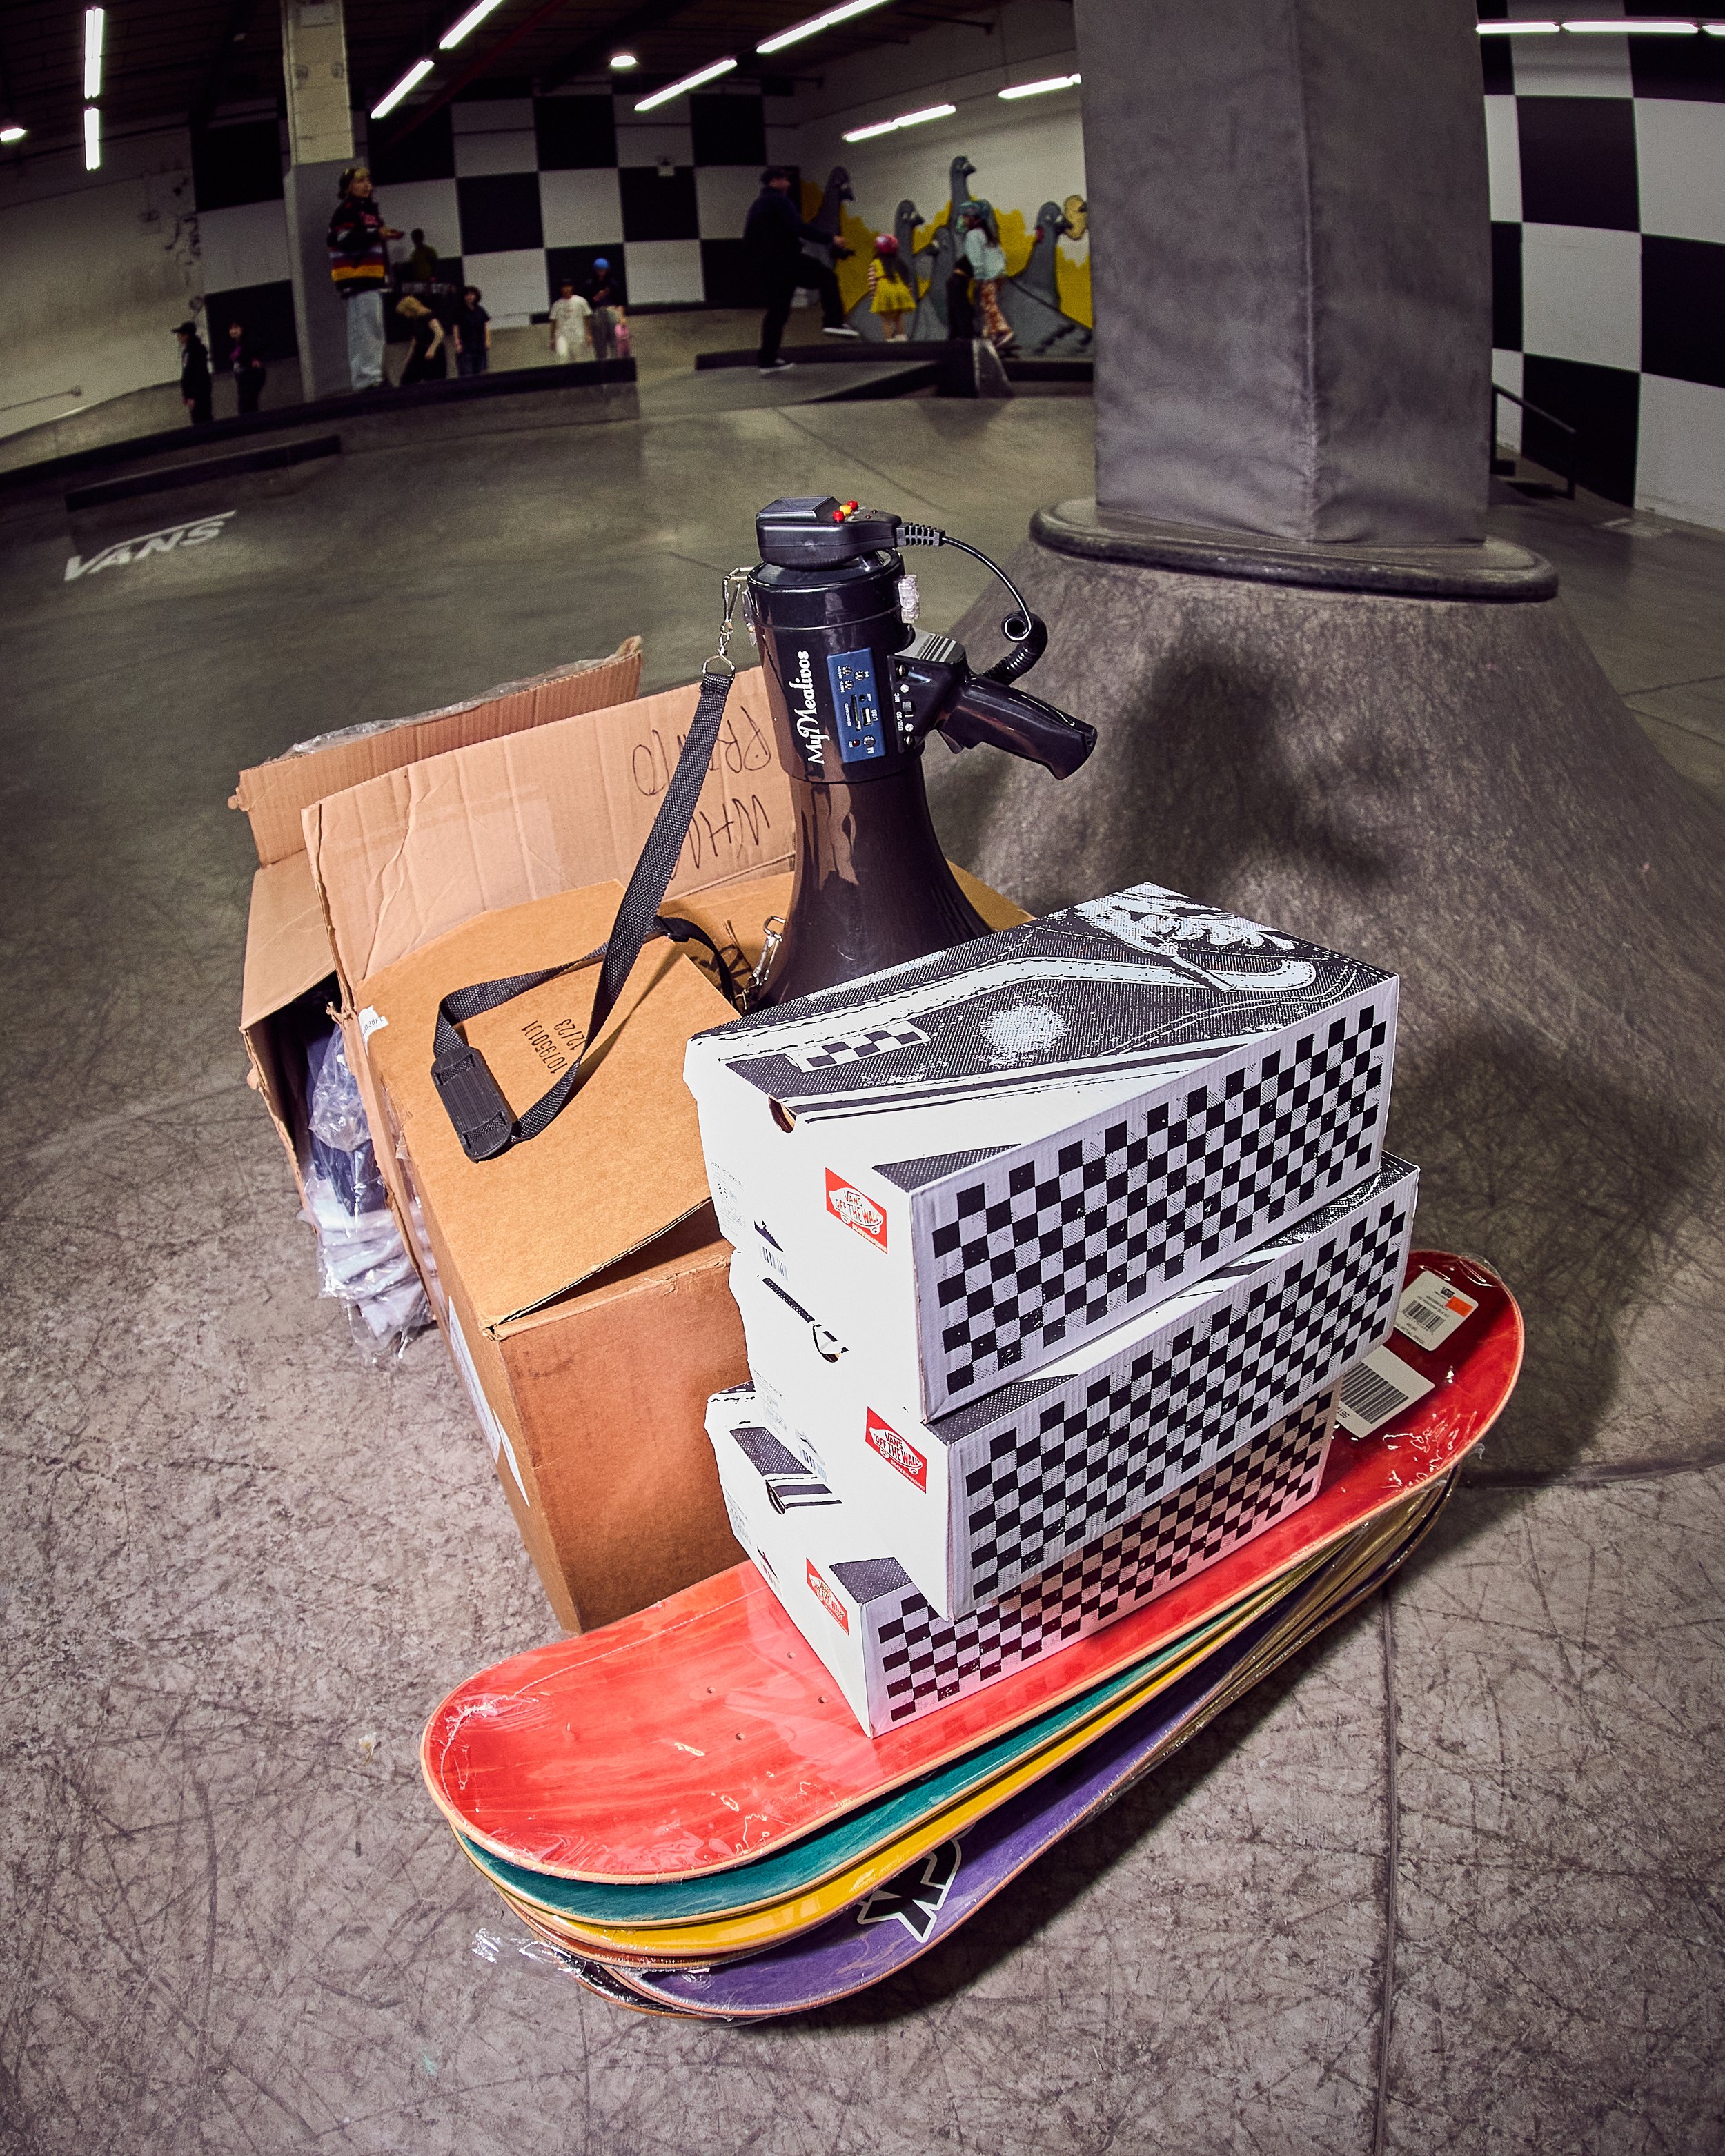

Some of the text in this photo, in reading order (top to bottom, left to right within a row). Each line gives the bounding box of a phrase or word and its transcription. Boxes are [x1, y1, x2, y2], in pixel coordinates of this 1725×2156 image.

[64, 510, 237, 581] VANS
[553, 1018, 586, 1051] 12/23
[885, 1431, 903, 1450] VANS
[887, 1443, 901, 1462] THE
[890, 1459, 925, 1490] SKATEBOARDING
